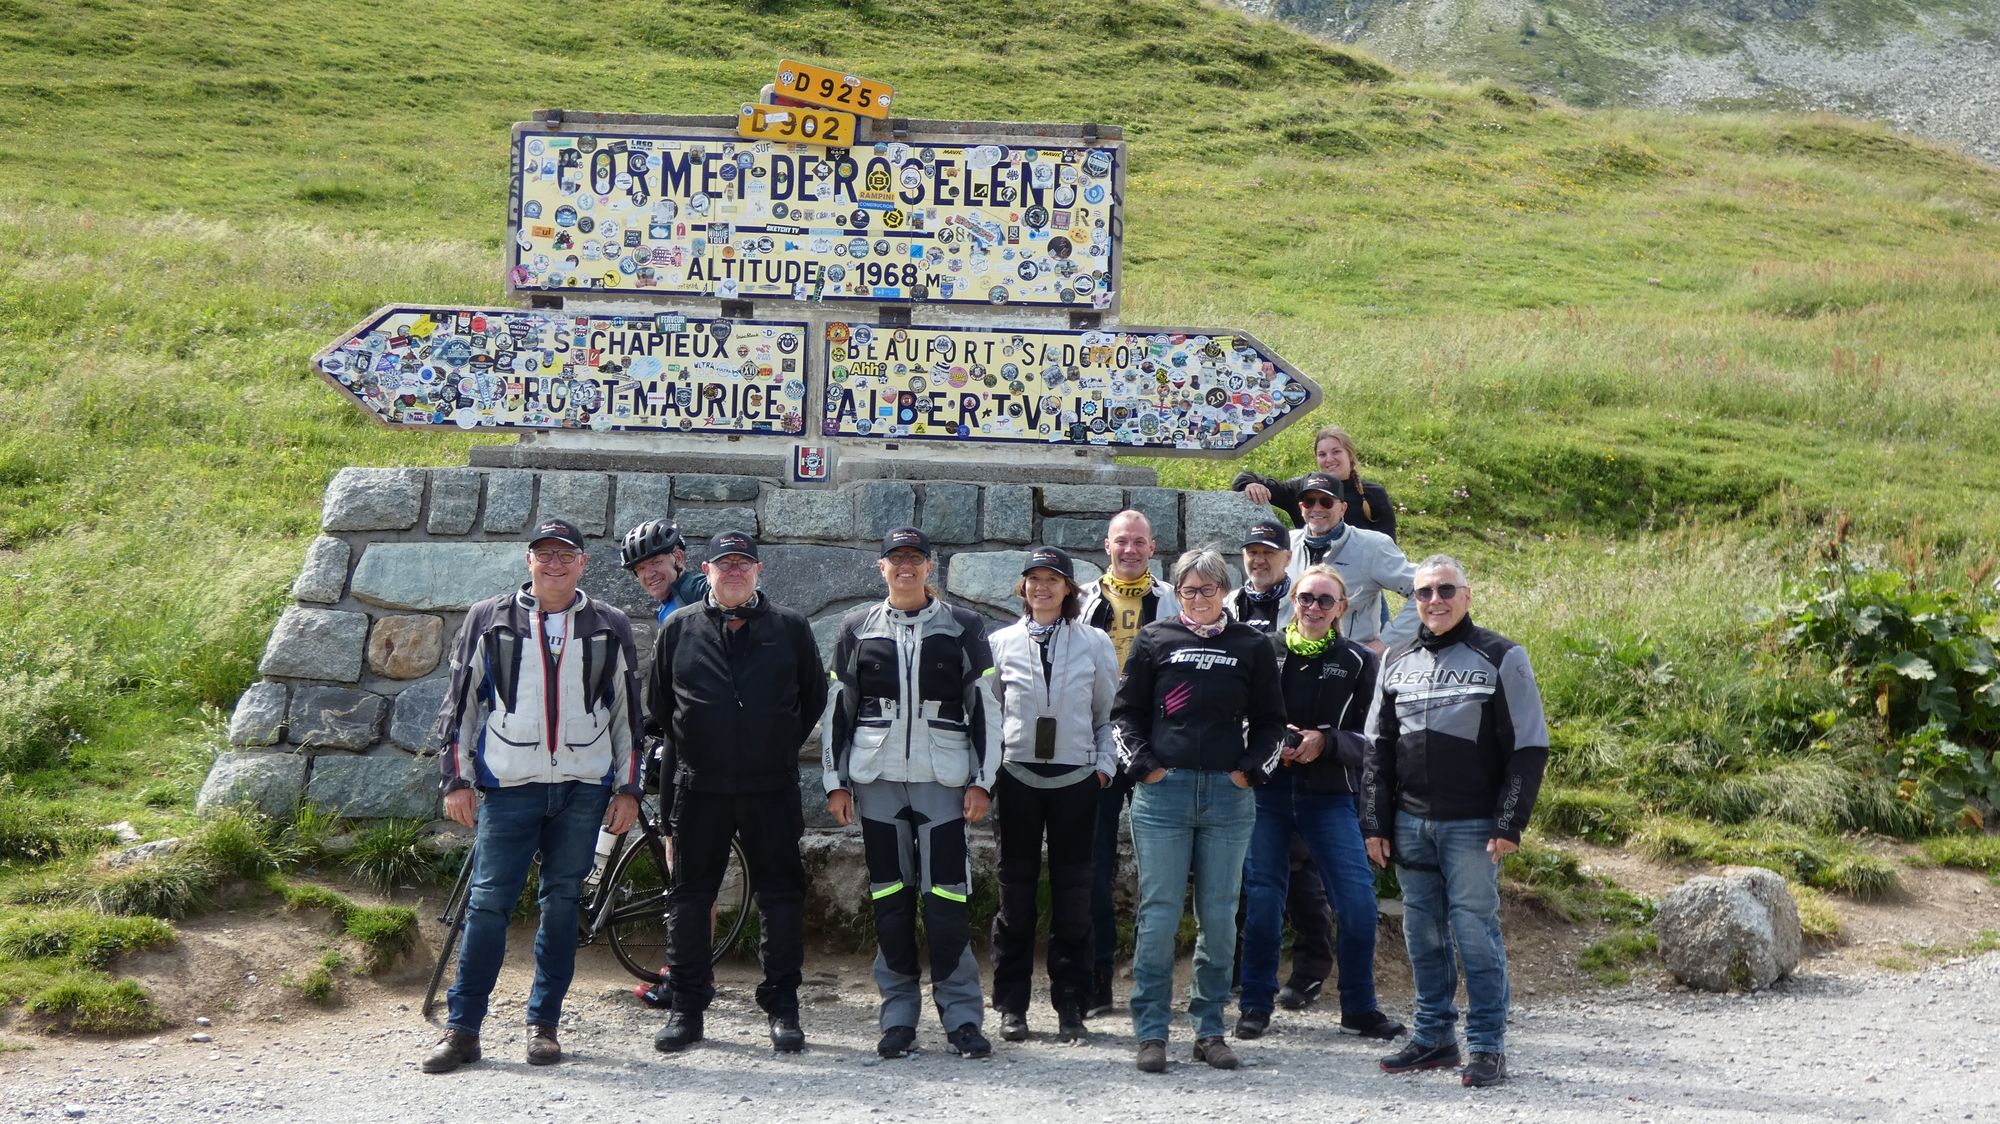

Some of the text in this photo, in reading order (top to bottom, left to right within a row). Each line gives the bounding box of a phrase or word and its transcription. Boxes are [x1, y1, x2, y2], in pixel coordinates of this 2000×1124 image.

[795, 72, 872, 107] D 925
[752, 109, 840, 140] D 902
[770, 154, 819, 202] DE
[859, 191, 895, 201] RAMPINI
[686, 257, 819, 285] ALTITUDE
[855, 262, 918, 288] 1968
[590, 331, 729, 359] CHAPIEUX
[847, 336, 995, 365] BEAUFORT
[836, 388, 1140, 434] ALBERTVILL
[1388, 669, 1490, 687] BERING
